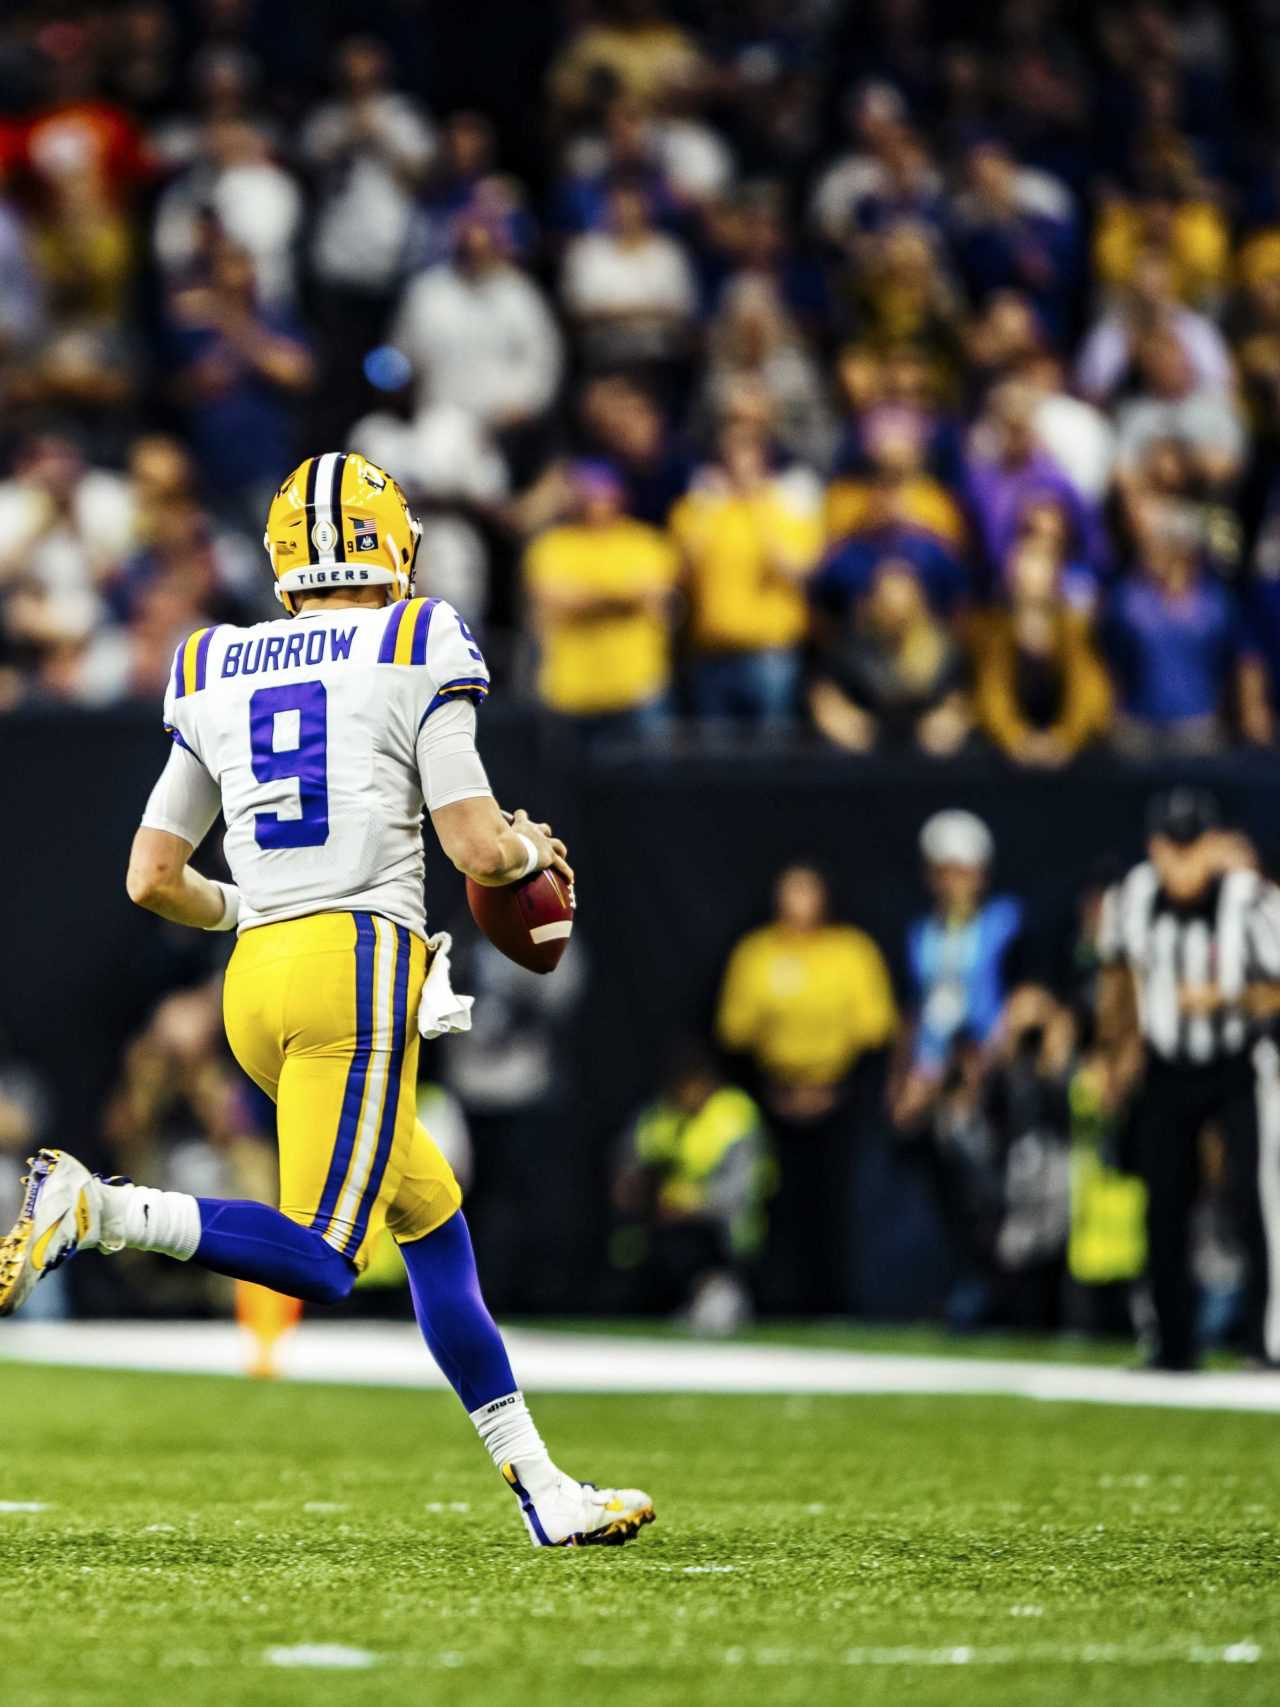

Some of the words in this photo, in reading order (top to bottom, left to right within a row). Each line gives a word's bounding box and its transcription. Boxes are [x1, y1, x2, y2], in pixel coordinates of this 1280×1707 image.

[347, 541, 354, 553] 9
[297, 569, 370, 585] TIGERS
[220, 625, 358, 679] BURROW
[248, 680, 330, 850] 9
